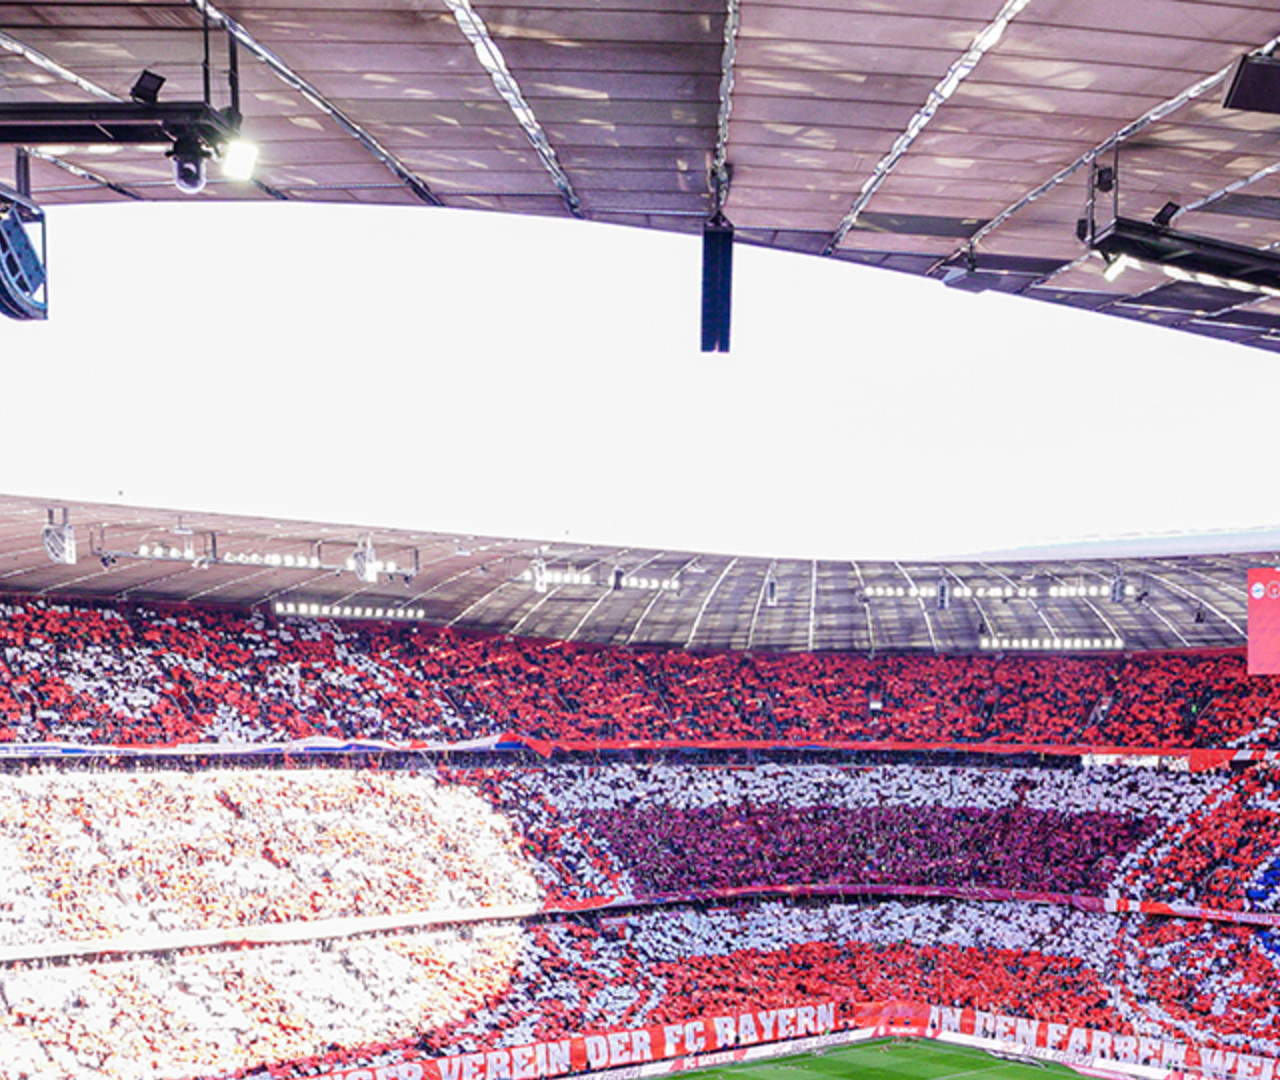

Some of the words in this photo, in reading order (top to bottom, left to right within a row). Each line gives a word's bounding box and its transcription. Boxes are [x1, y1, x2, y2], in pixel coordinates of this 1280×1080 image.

[584, 1029, 653, 1068] DER
[663, 1020, 706, 1057] FC
[713, 1002, 835, 1048] BAYERN
[929, 1004, 962, 1033] IN
[975, 1010, 1040, 1048] DEN
[1047, 1023, 1187, 1070] FARBEN
